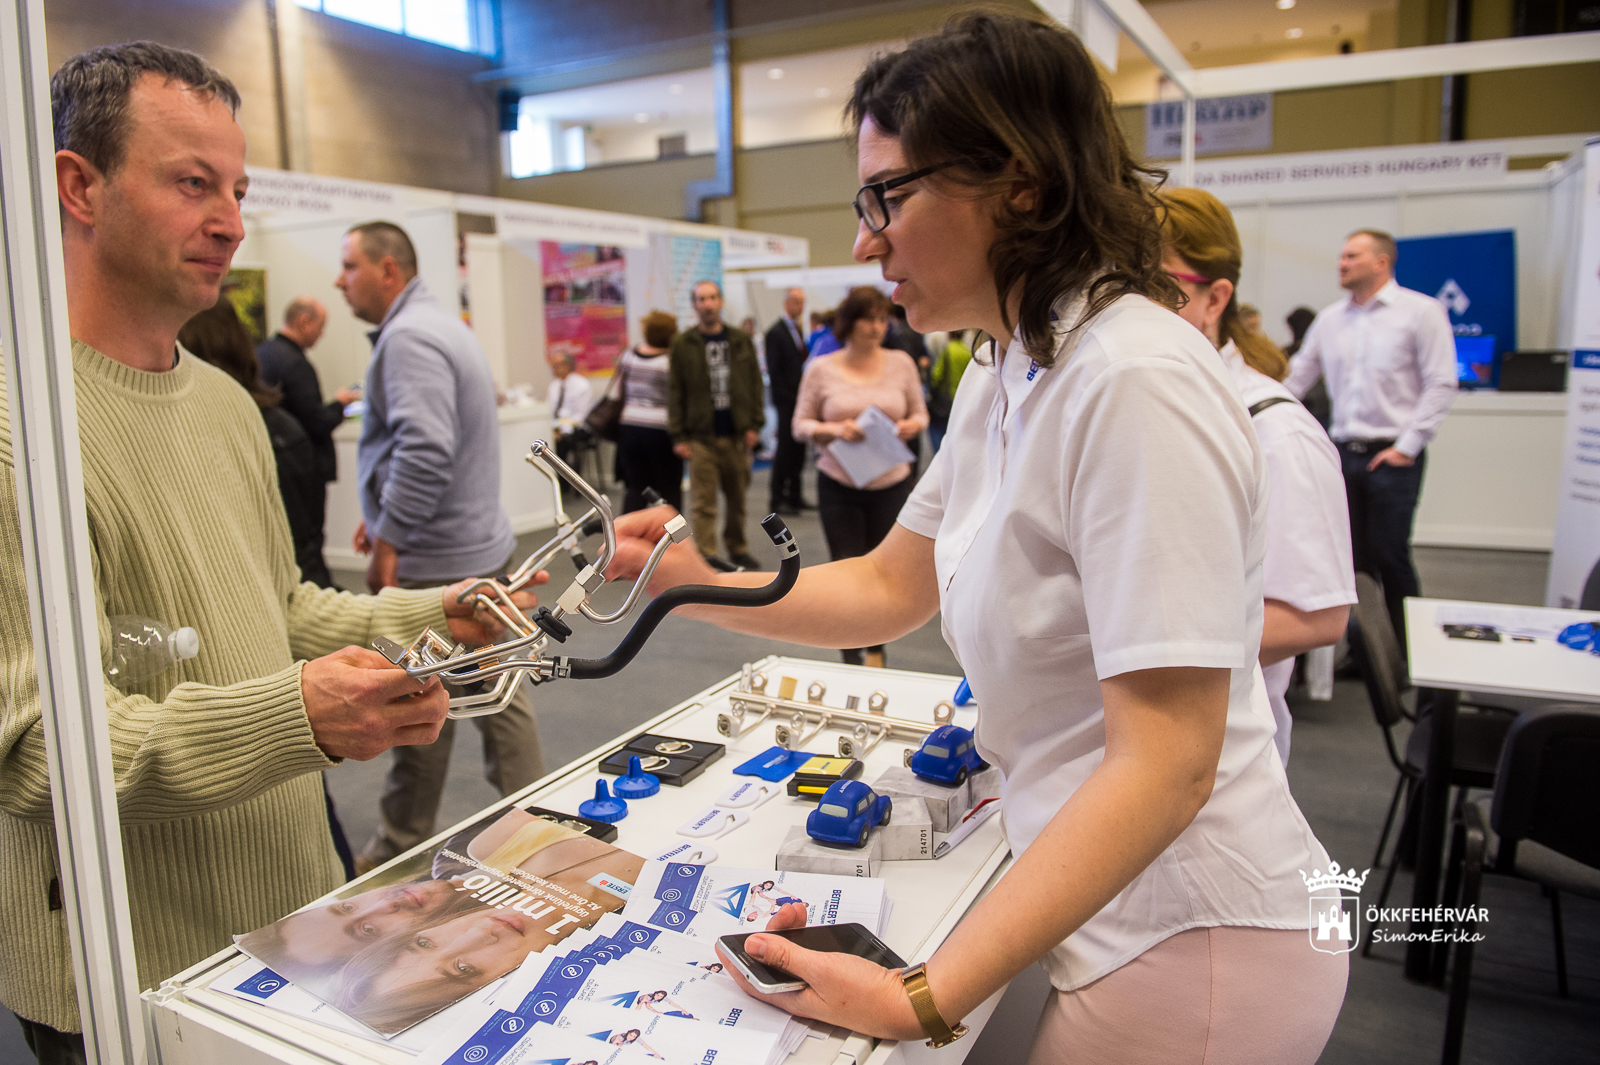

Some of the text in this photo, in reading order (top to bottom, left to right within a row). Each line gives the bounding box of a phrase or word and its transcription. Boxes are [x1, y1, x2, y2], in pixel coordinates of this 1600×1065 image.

[1290, 161, 1372, 182] SERVICES
[1378, 155, 1464, 174] HUNGARY
[455, 875, 557, 920] millió
[546, 882, 571, 897] most
[606, 883, 628, 894] ERSTE
[587, 902, 602, 911] Az
[827, 890, 842, 919] BENTELER
[545, 913, 581, 935] 1
